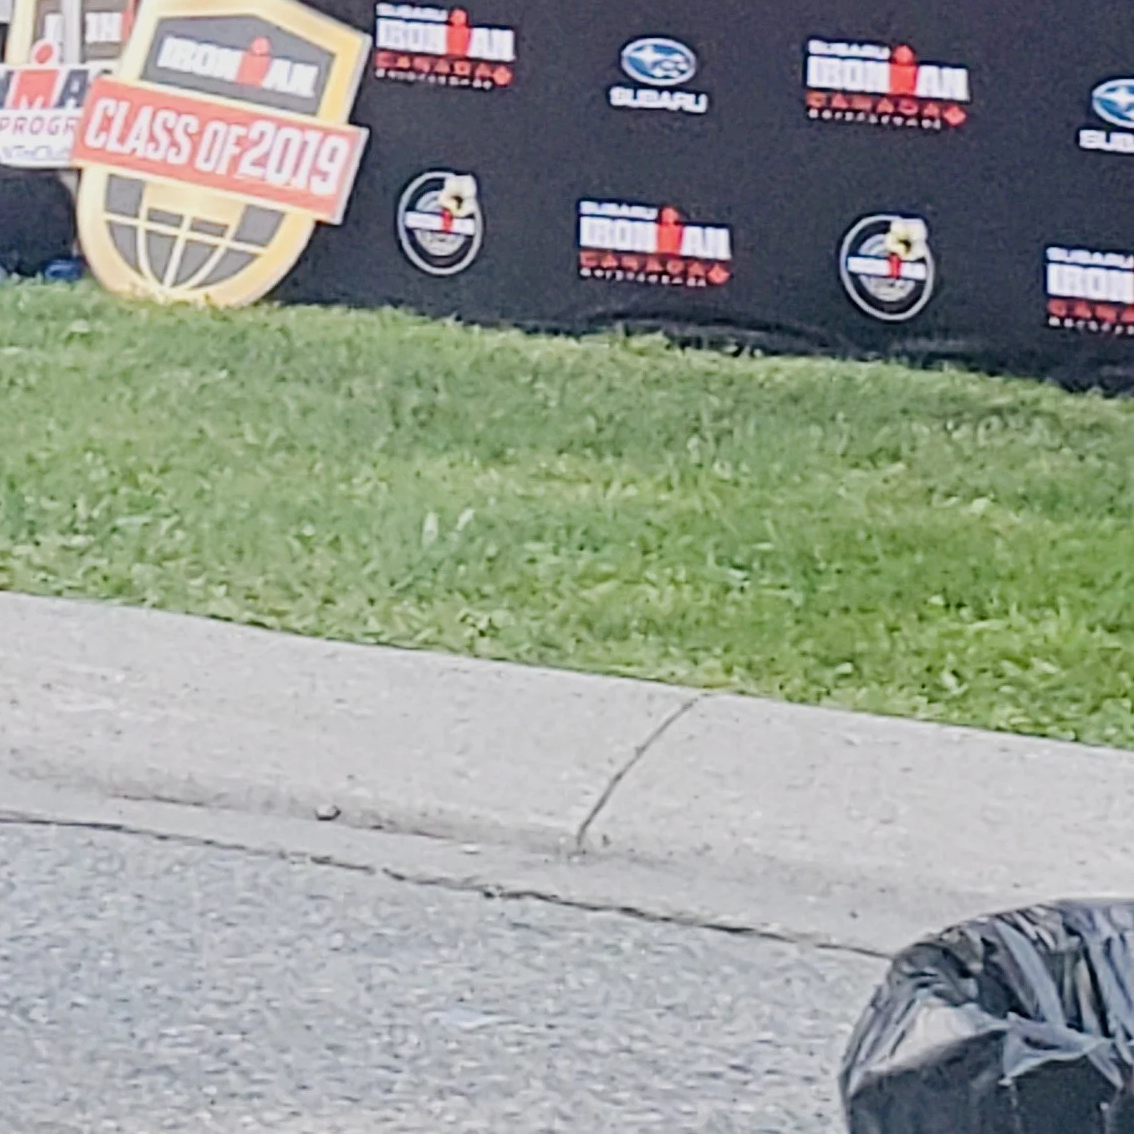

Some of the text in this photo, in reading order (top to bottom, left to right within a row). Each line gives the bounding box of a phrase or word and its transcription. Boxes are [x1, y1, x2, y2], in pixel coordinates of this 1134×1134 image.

[376, 8, 515, 62] IRONMAN
[157, 34, 319, 98] IRONMAN
[807, 46, 969, 101] IRONMAN
[610, 87, 707, 113] SUBARU
[84, 97, 350, 196] CLASS OF 2019
[1079, 130, 1134, 152] SUB
[580, 206, 731, 260] IRONMAN
[1046, 263, 1134, 304] IRON
